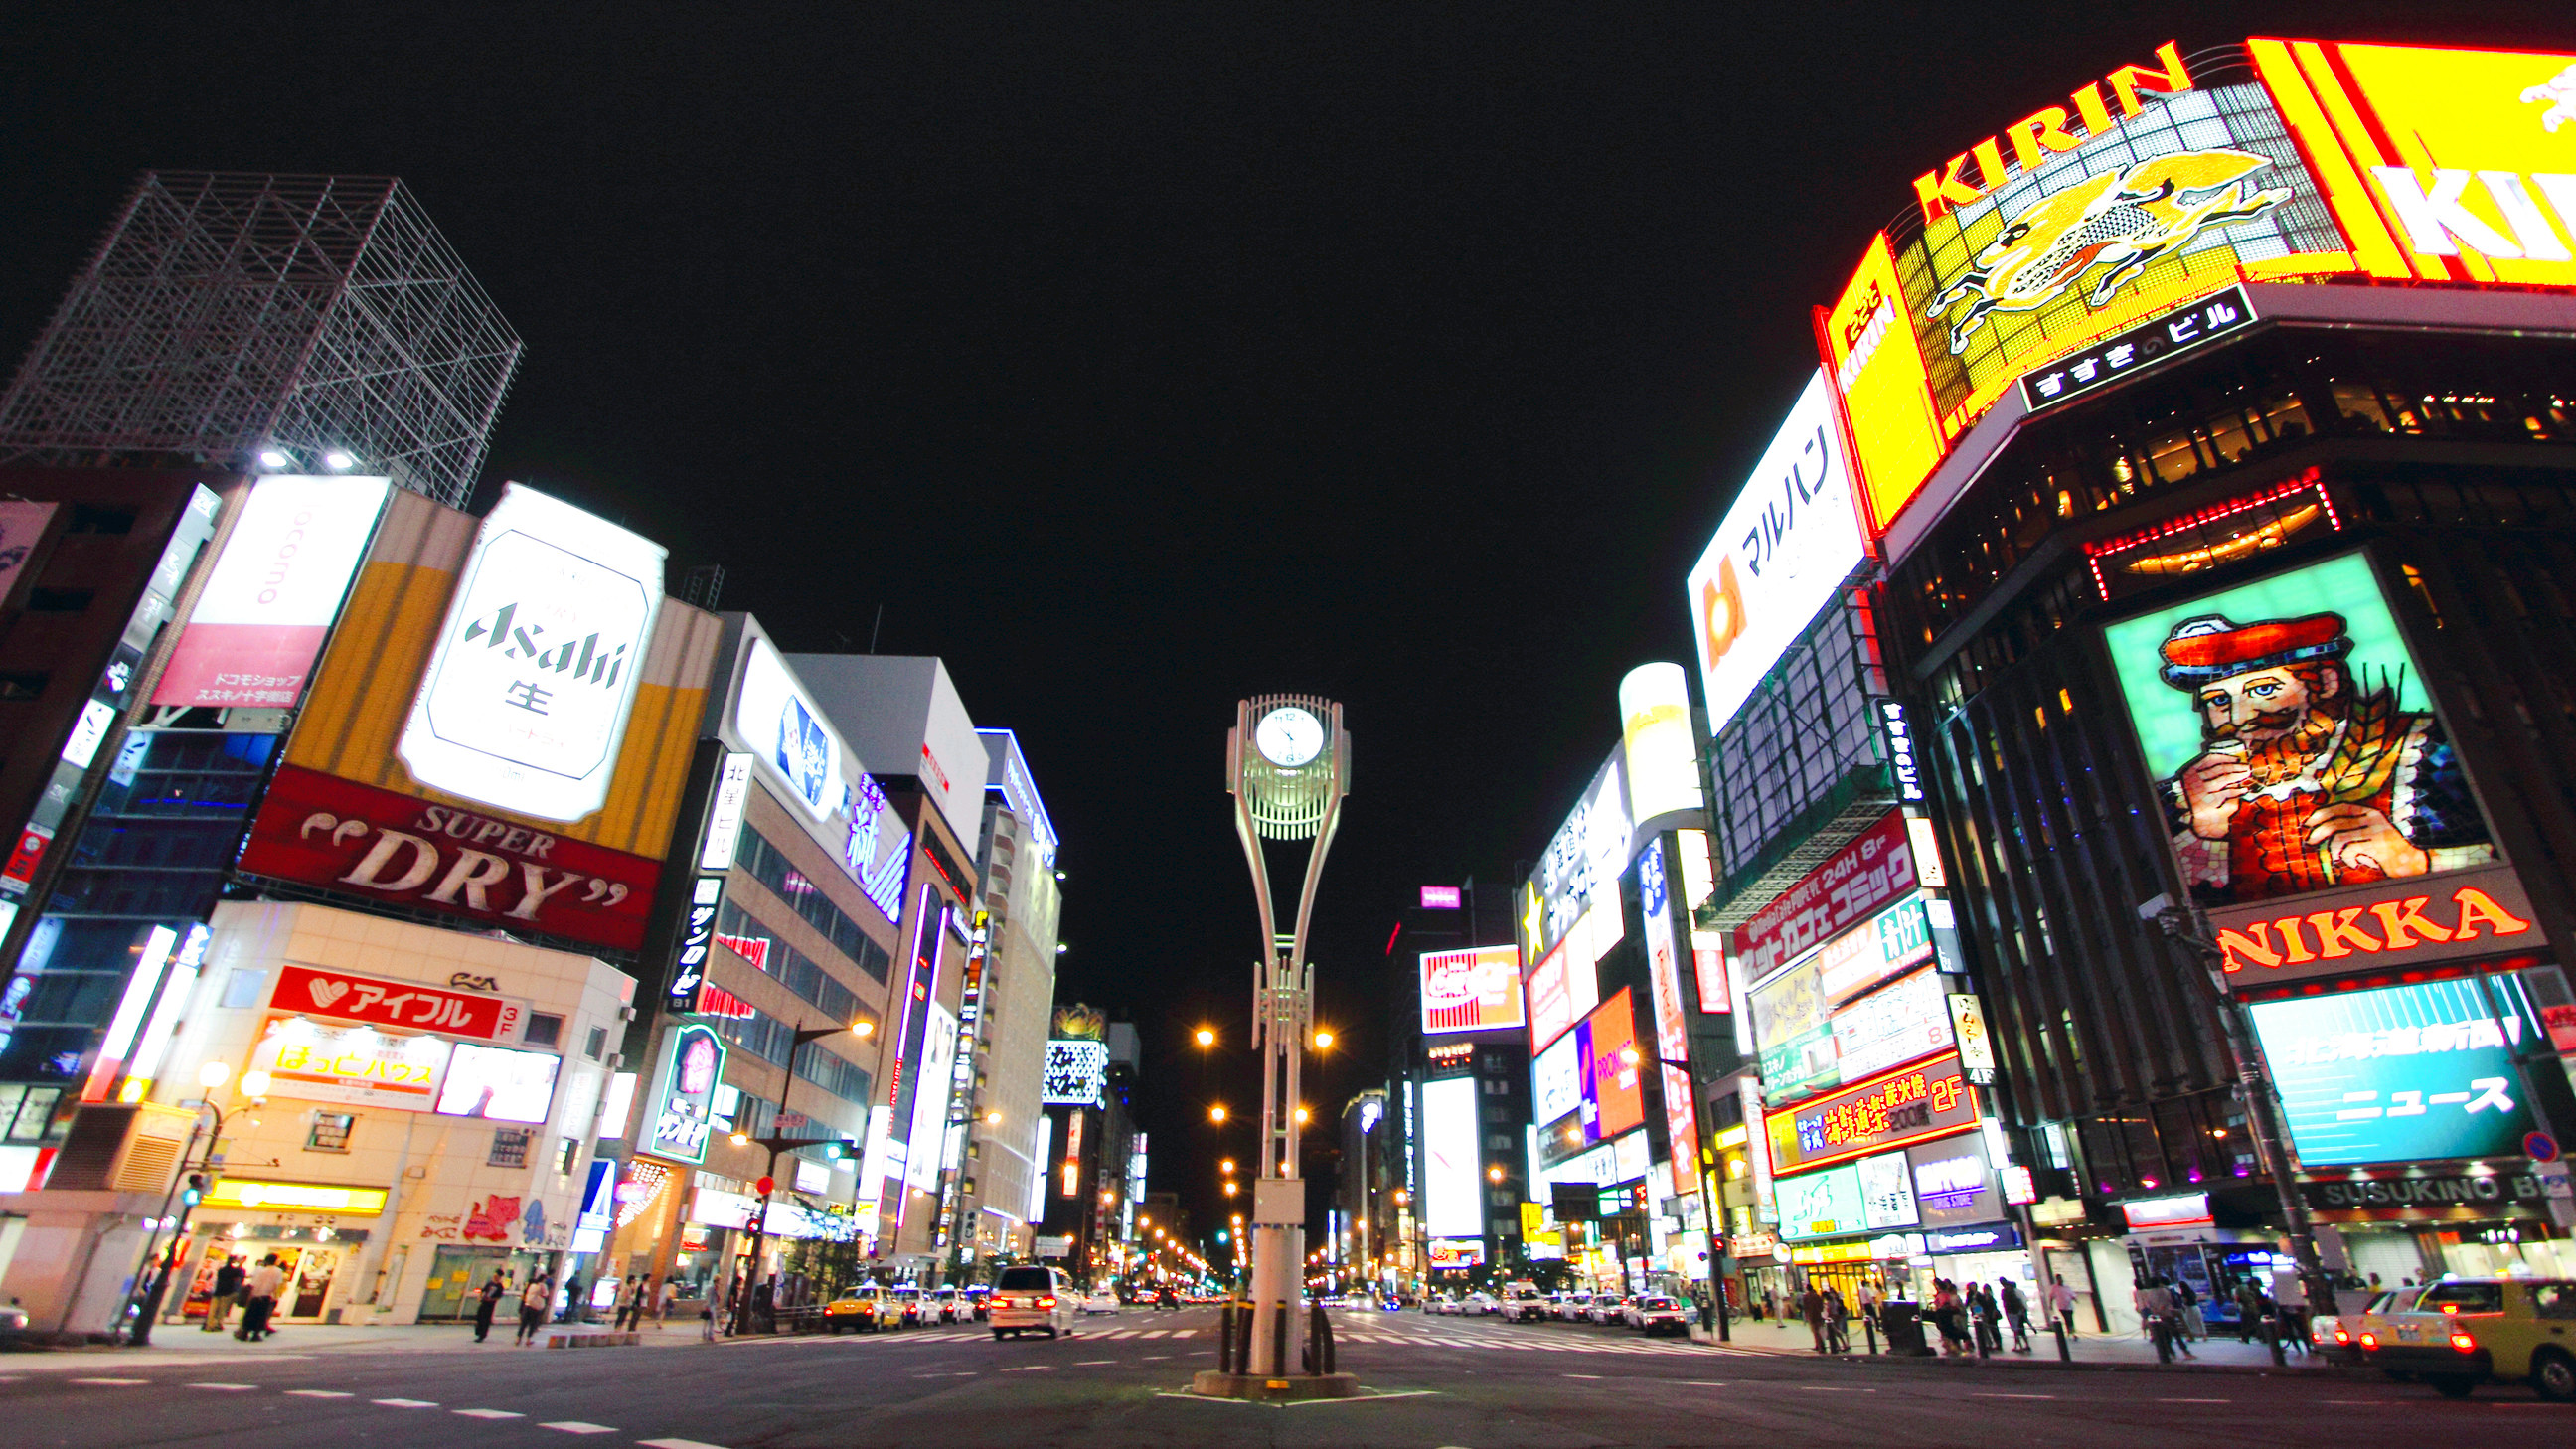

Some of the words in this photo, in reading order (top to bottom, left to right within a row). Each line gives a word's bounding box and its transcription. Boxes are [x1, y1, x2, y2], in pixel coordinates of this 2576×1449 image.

[1913, 40, 2195, 226] KIRIN
[1838, 294, 1897, 395] KIRIN
[2036, 301, 2236, 398] すすきのビル
[1742, 425, 1828, 577] マルハン
[257, 502, 322, 605] ocomo
[464, 601, 628, 690] Asahi
[215, 672, 302, 688] ドコモショップ
[505, 679, 555, 716] 生
[414, 805, 556, 860] SUPER
[1823, 850, 1858, 889] 24H
[1830, 842, 1916, 926] コミック
[670, 906, 715, 996] サンローゼ
[1881, 903, 1925, 959] 青汁
[2216, 886, 2531, 974] NIKKA
[349, 983, 473, 1029] アイフル
[499, 1006, 519, 1037] 3F
[2287, 1015, 2522, 1065] 北海道新聞
[1930, 1075, 1964, 1113] 2F
[2336, 1076, 2515, 1121] ニュース
[2326, 1174, 2500, 1206] SUSUKINO
